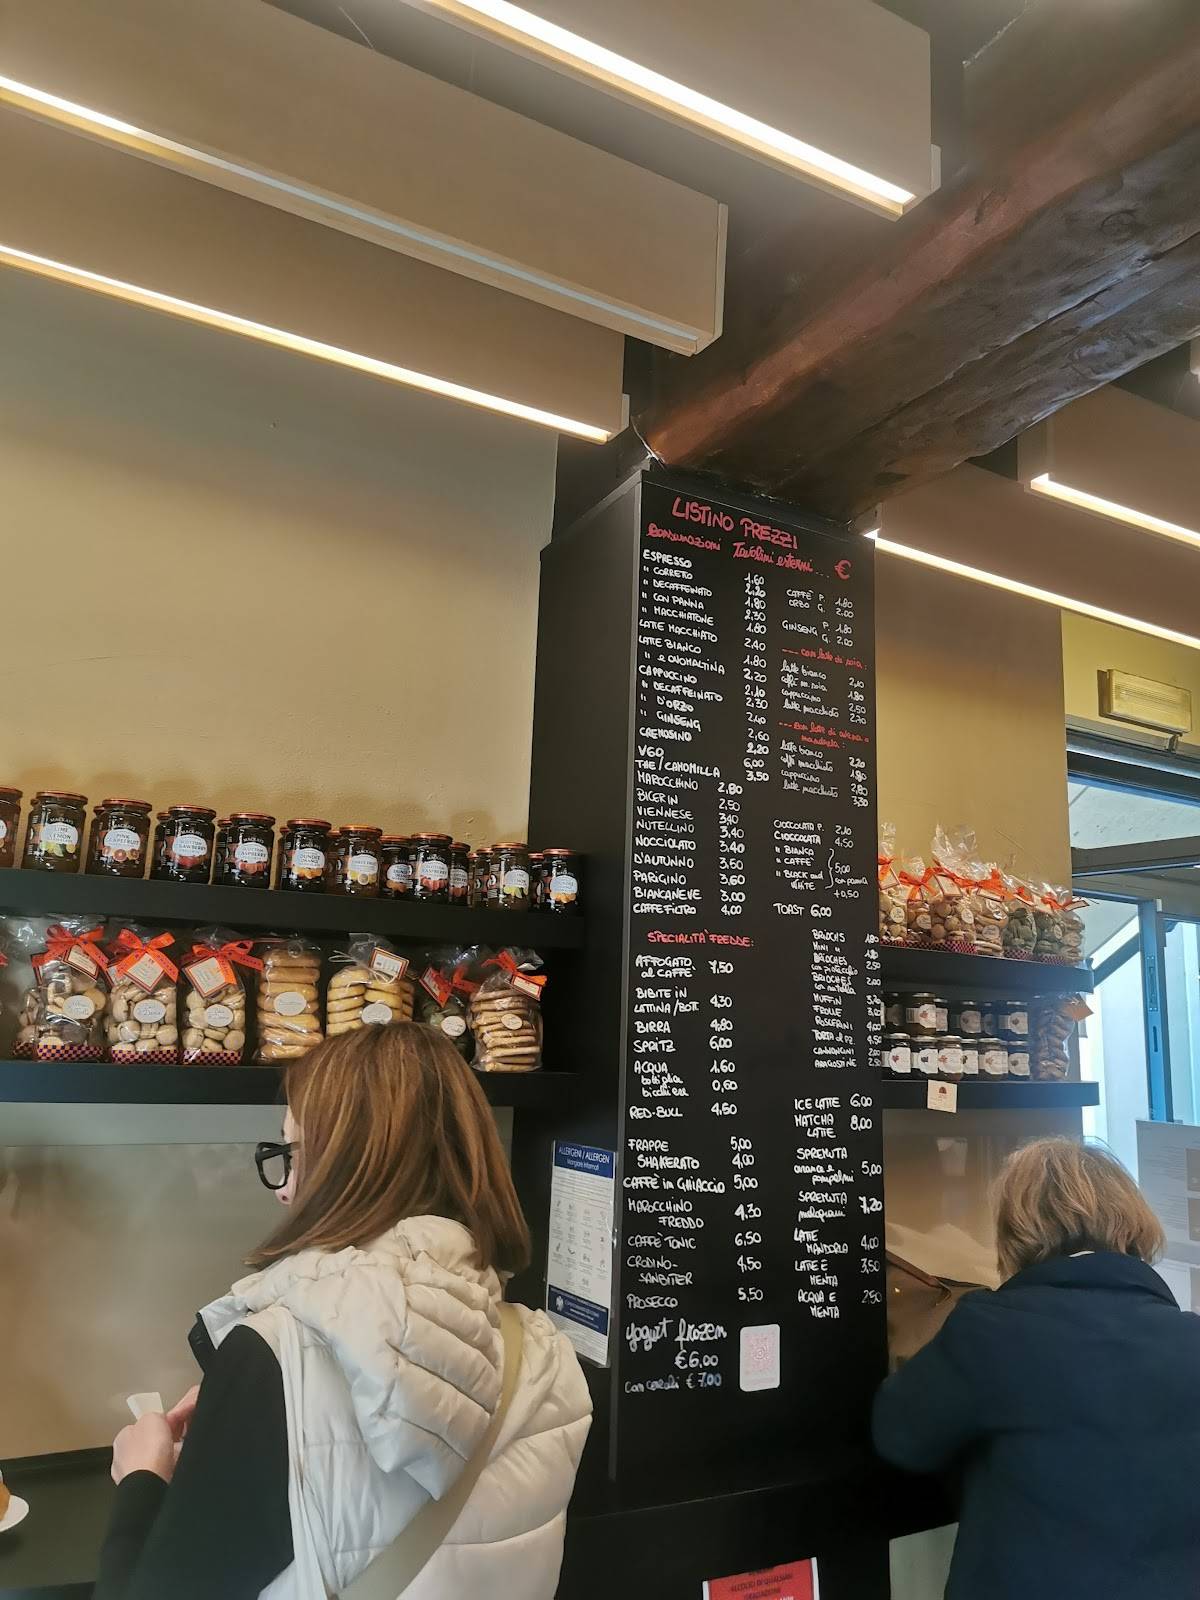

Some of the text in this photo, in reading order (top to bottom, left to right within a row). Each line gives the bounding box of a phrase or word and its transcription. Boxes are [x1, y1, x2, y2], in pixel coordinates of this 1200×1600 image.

[672, 496, 798, 549] LISTINO PREZZI
[642, 549, 692, 568] ESPRESSO
[653, 579, 712, 597] DECAFFEINATO
[653, 593, 669, 603] CON
[672, 595, 704, 610] PANNA
[653, 606, 714, 626] MACCHIATONE
[639, 619, 665, 631] LATTE
[668, 624, 718, 643] MACCHIATO
[782, 620, 818, 636] GINSENG
[639, 635, 662, 648] LATTE
[664, 639, 701, 654] BIANCO
[638, 665, 697, 684] CAPPUCCINO
[653, 681, 723, 702] DECAFFEINATO
[656, 711, 701, 732] GINSENG
[637, 770, 698, 790] MAROCCHINO
[636, 806, 694, 820] VIENNESE
[636, 819, 695, 833] NUTELLINO
[635, 834, 696, 850] NOCCIOLATO
[633, 852, 694, 869] D'AUTUNNO
[633, 870, 687, 885] PARIGINO
[633, 886, 702, 901] BIANCANEVE
[773, 903, 805, 916] TOAST
[635, 954, 692, 968] AFFOGATO
[636, 987, 672, 999] BIBITE
[634, 1021, 671, 1034] BIRRA
[634, 1060, 668, 1075] ACQUA
[794, 1098, 813, 1110] ICE
[815, 1097, 841, 1110] LATTE
[794, 1113, 834, 1127] MATCHA
[807, 1127, 836, 1139] LATTE
[796, 1147, 848, 1160] SPREMUTA
[637, 1154, 700, 1170] SHAKERATO
[677, 1175, 726, 1194] GHIACCIO
[628, 1196, 693, 1214] MAROCCHINO
[798, 1191, 848, 1205] SPREMUTA
[658, 1215, 704, 1229] FREDDO
[664, 1235, 697, 1250] TONIC
[734, 1231, 762, 1247] 6,50
[794, 1227, 819, 1243] LATTE
[795, 1260, 819, 1272] LATTE
[810, 1273, 838, 1287] MENTA
[626, 1293, 678, 1309] PROSECCO
[798, 1289, 837, 1303] ACQUA E
[810, 1305, 840, 1319] MENTA
